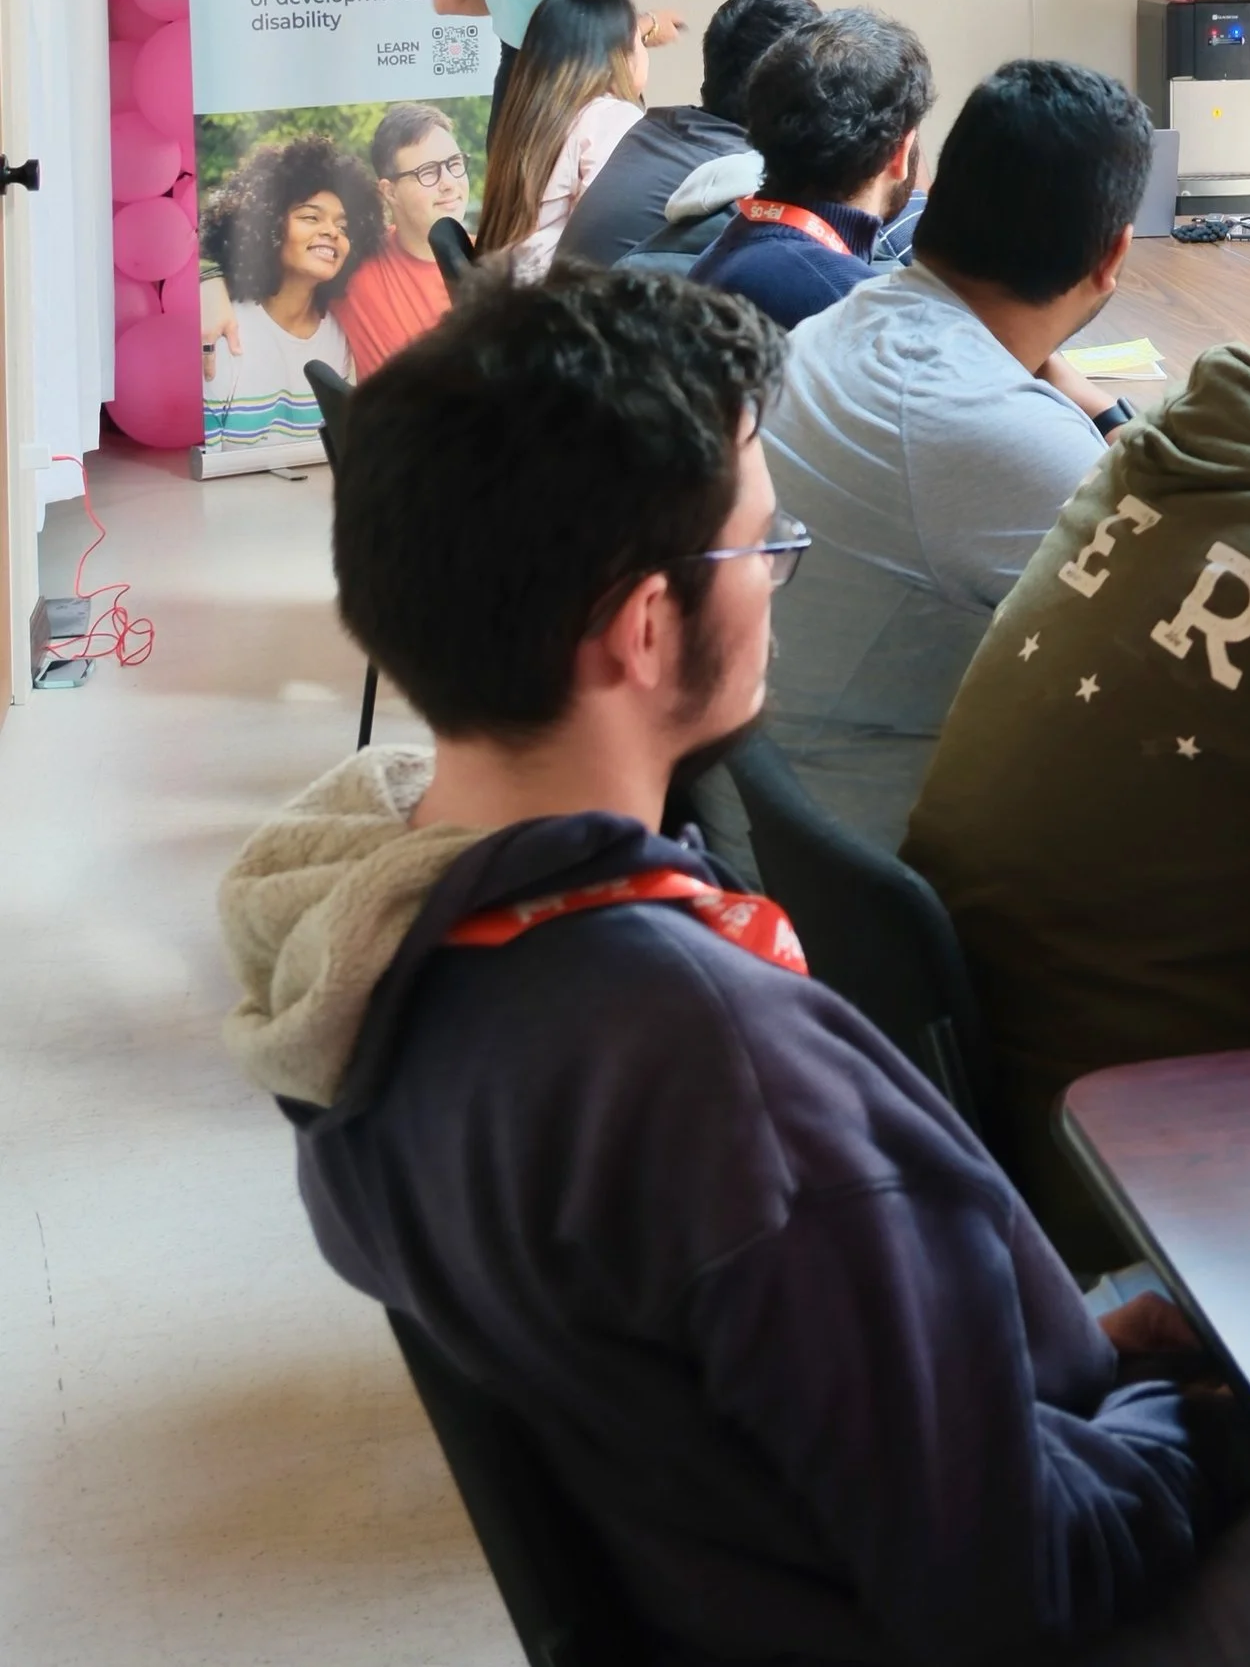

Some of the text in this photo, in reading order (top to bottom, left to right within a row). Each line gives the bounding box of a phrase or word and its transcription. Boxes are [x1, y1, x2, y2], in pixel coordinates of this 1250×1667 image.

[251, 11, 342, 32] disability
[376, 41, 420, 54] LEARN
[377, 53, 416, 66] MORE
